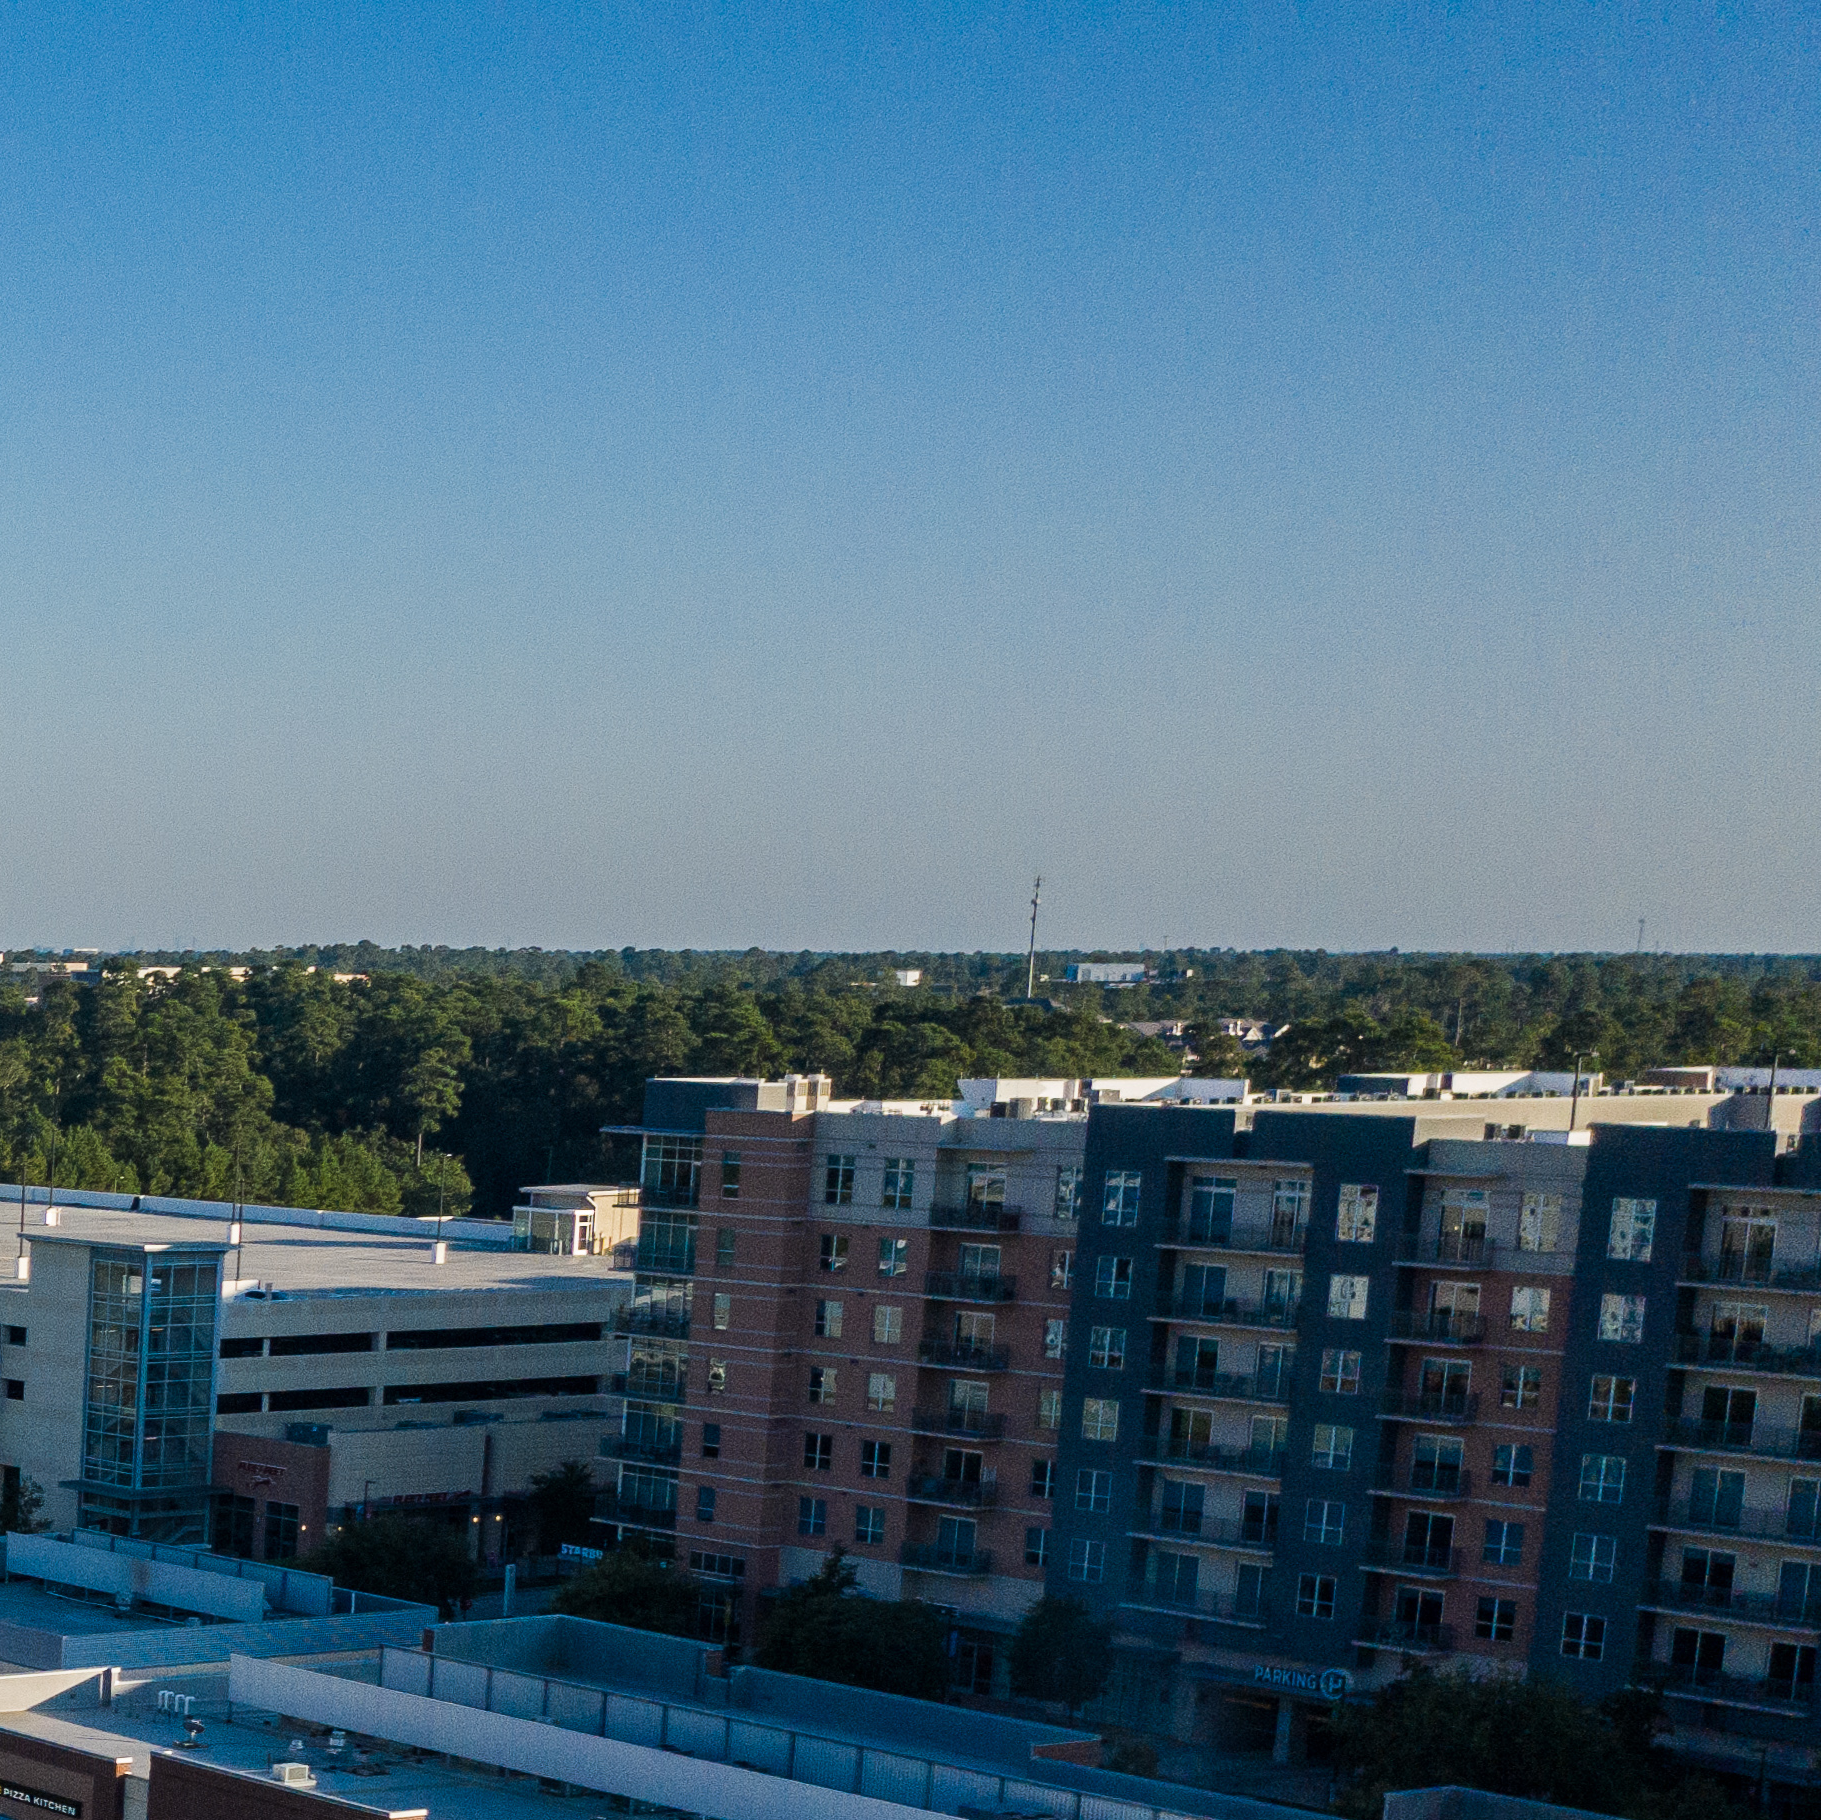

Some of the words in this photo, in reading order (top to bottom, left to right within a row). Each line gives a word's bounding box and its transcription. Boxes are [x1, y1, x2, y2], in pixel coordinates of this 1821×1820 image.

[1254, 1665, 1317, 1690] PARKING
[3, 1787, 31, 1803] PIZZA
[33, 1796, 76, 1816] KITCHEN
